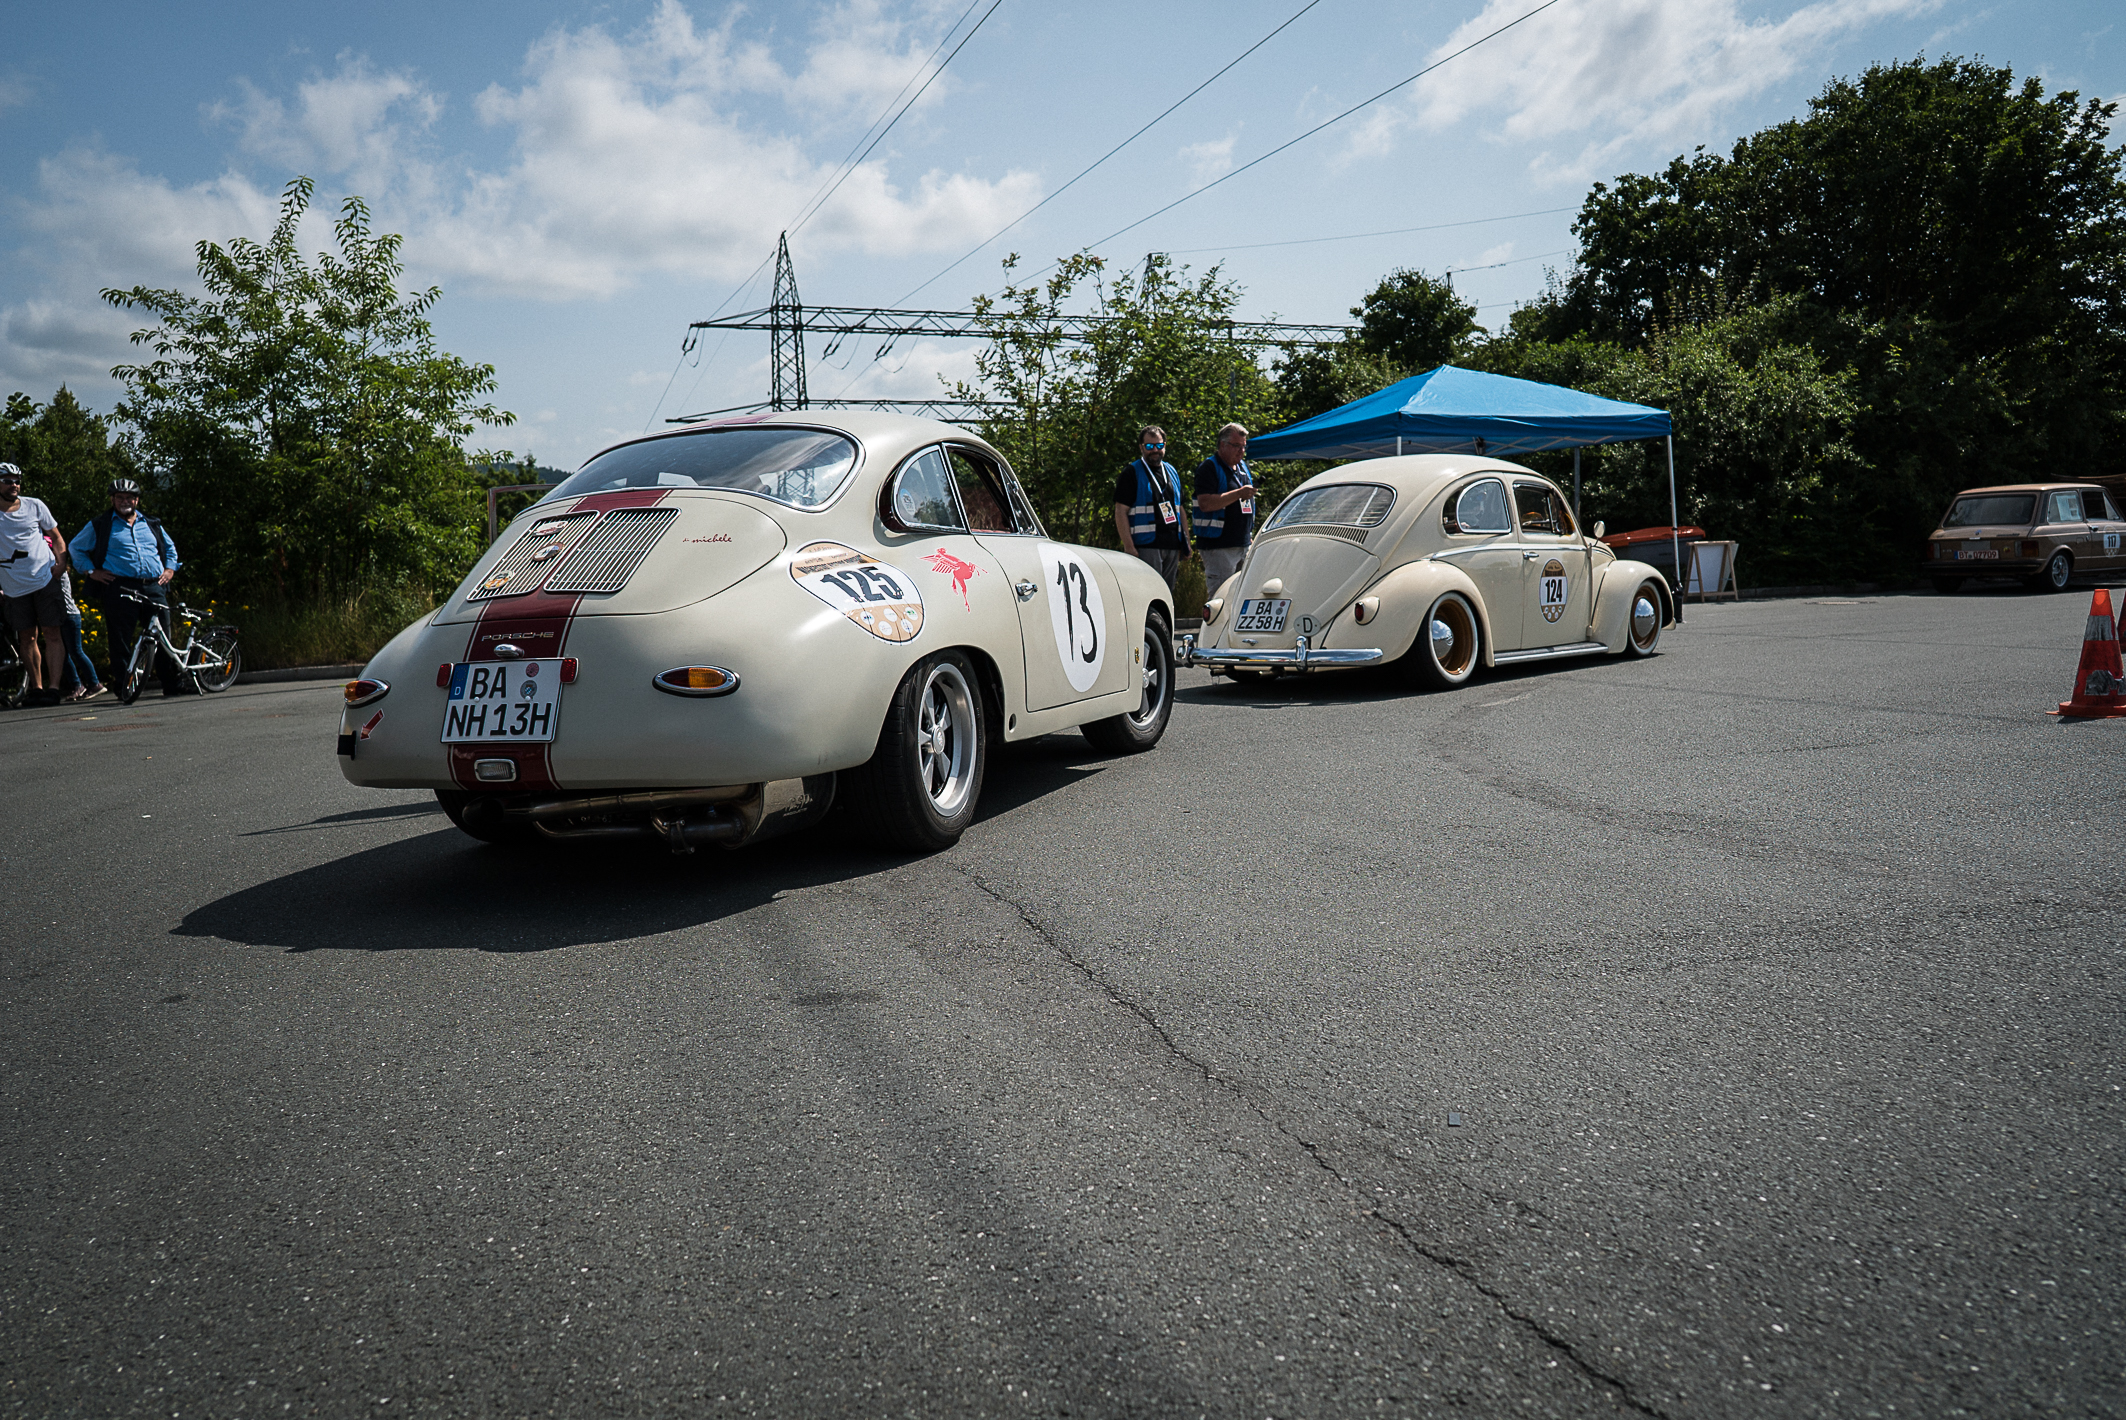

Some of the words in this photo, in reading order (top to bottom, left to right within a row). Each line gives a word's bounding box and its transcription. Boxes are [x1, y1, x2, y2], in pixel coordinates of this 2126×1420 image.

[2107, 535, 2117, 548] 117
[1959, 551, 1968, 559] BT
[820, 566, 904, 603] 125
[1545, 578, 1563, 603] 124
[1056, 560, 1098, 664] 13
[1255, 601, 1273, 615] BA
[1237, 616, 1256, 630] ZZ
[1302, 617, 1313, 633] D
[481, 631, 555, 641] PORSCHE
[469, 666, 507, 699] BA
[454, 686, 462, 696] D
[446, 704, 488, 737] NH
[489, 702, 552, 736] 13H
